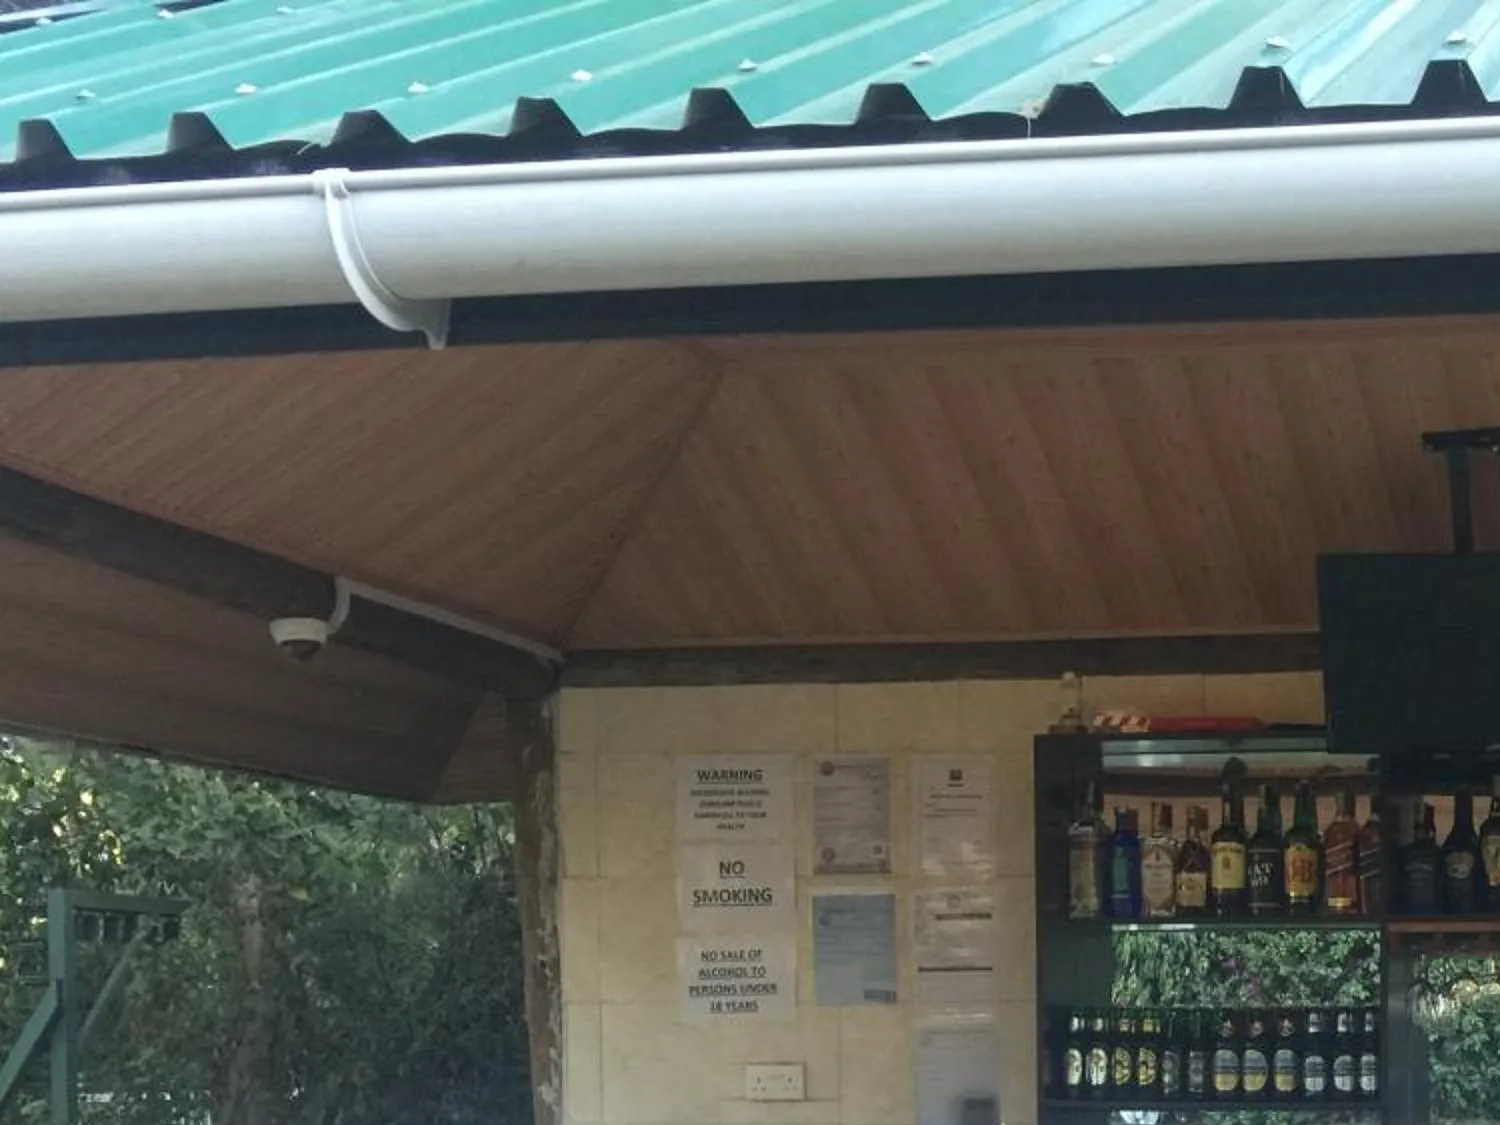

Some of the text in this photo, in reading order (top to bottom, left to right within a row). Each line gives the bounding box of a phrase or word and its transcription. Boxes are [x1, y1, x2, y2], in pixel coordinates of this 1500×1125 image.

[697, 768, 764, 781] WARNING
[719, 860, 745, 875] NO
[692, 887, 773, 903] SMOKING
[701, 950, 718, 961] NO
[720, 950, 745, 960] SALE
[698, 965, 767, 979] ALCOHOL TO
[688, 982, 778, 997] PERSONS UNDER
[710, 1000, 759, 1012] 18 YEARS
